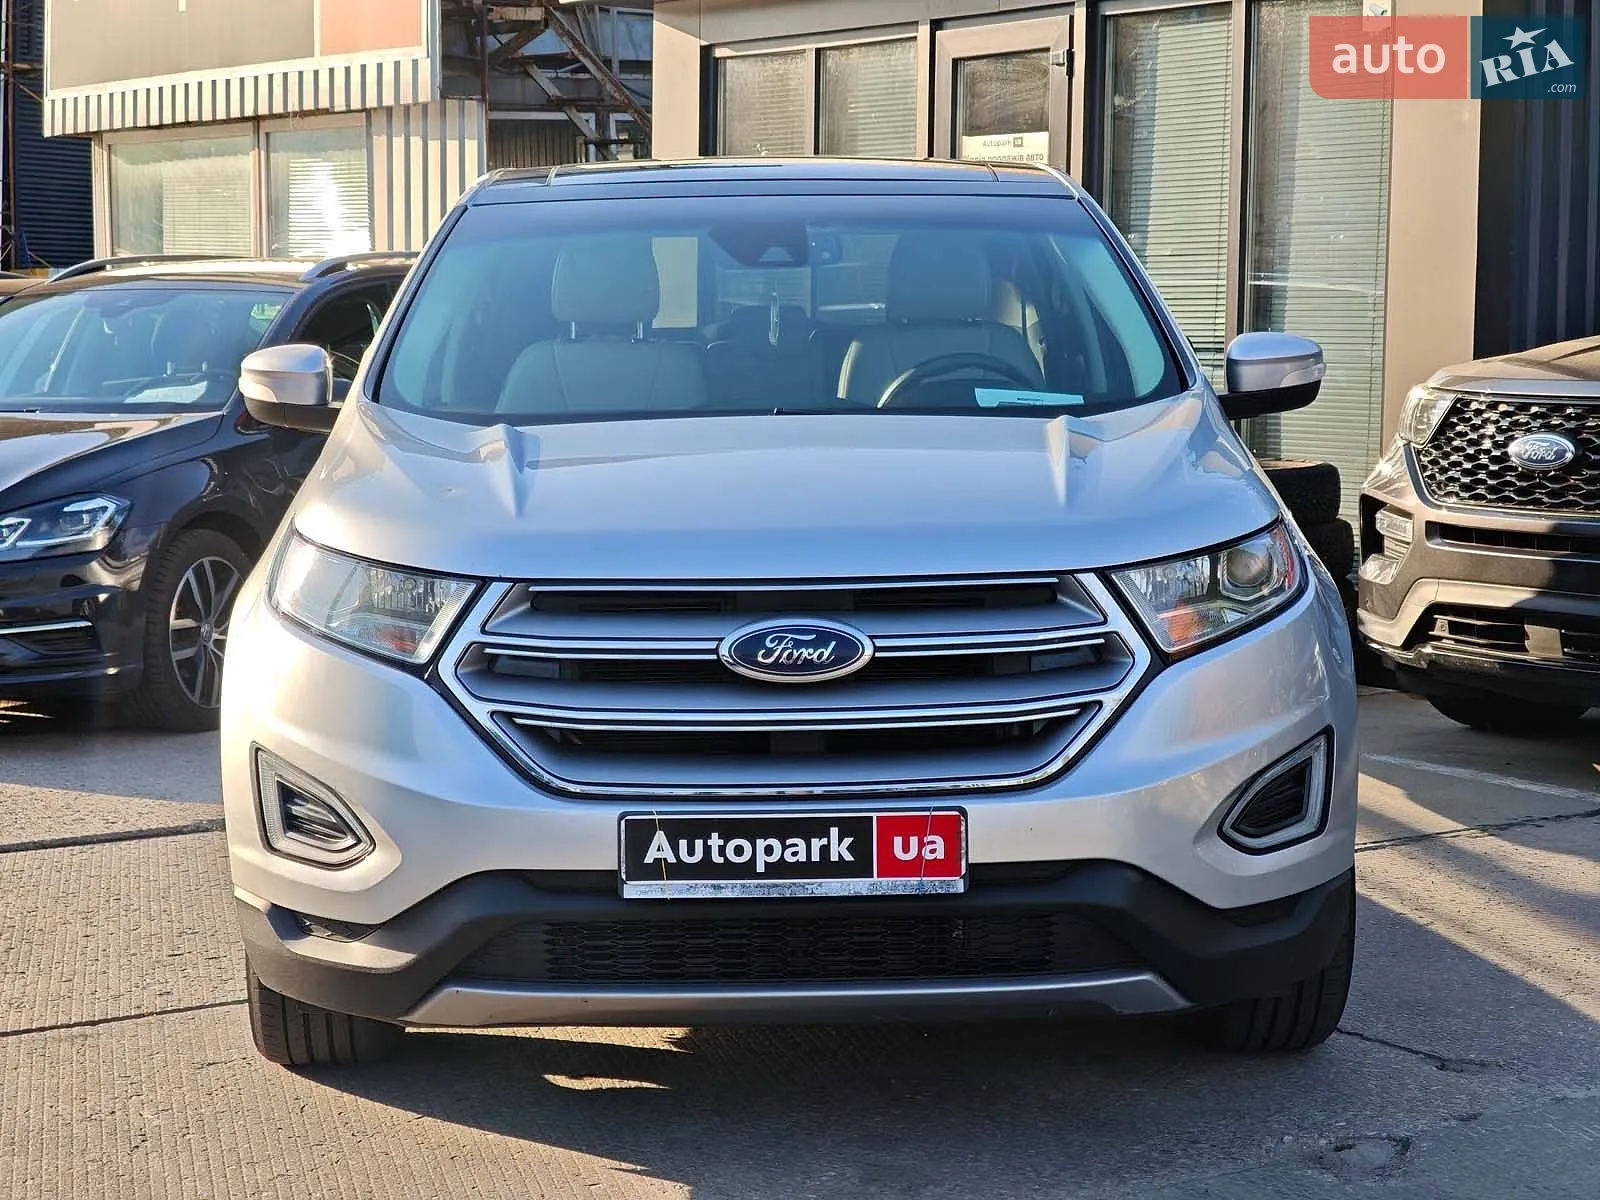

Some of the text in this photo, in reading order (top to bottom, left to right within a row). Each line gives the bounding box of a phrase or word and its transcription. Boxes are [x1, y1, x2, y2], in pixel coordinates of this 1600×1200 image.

[1026, 153, 1044, 161] авто
[1521, 441, 1561, 460] Ford
[757, 633, 837, 665] Ford
[643, 827, 945, 872] Autopark ua
